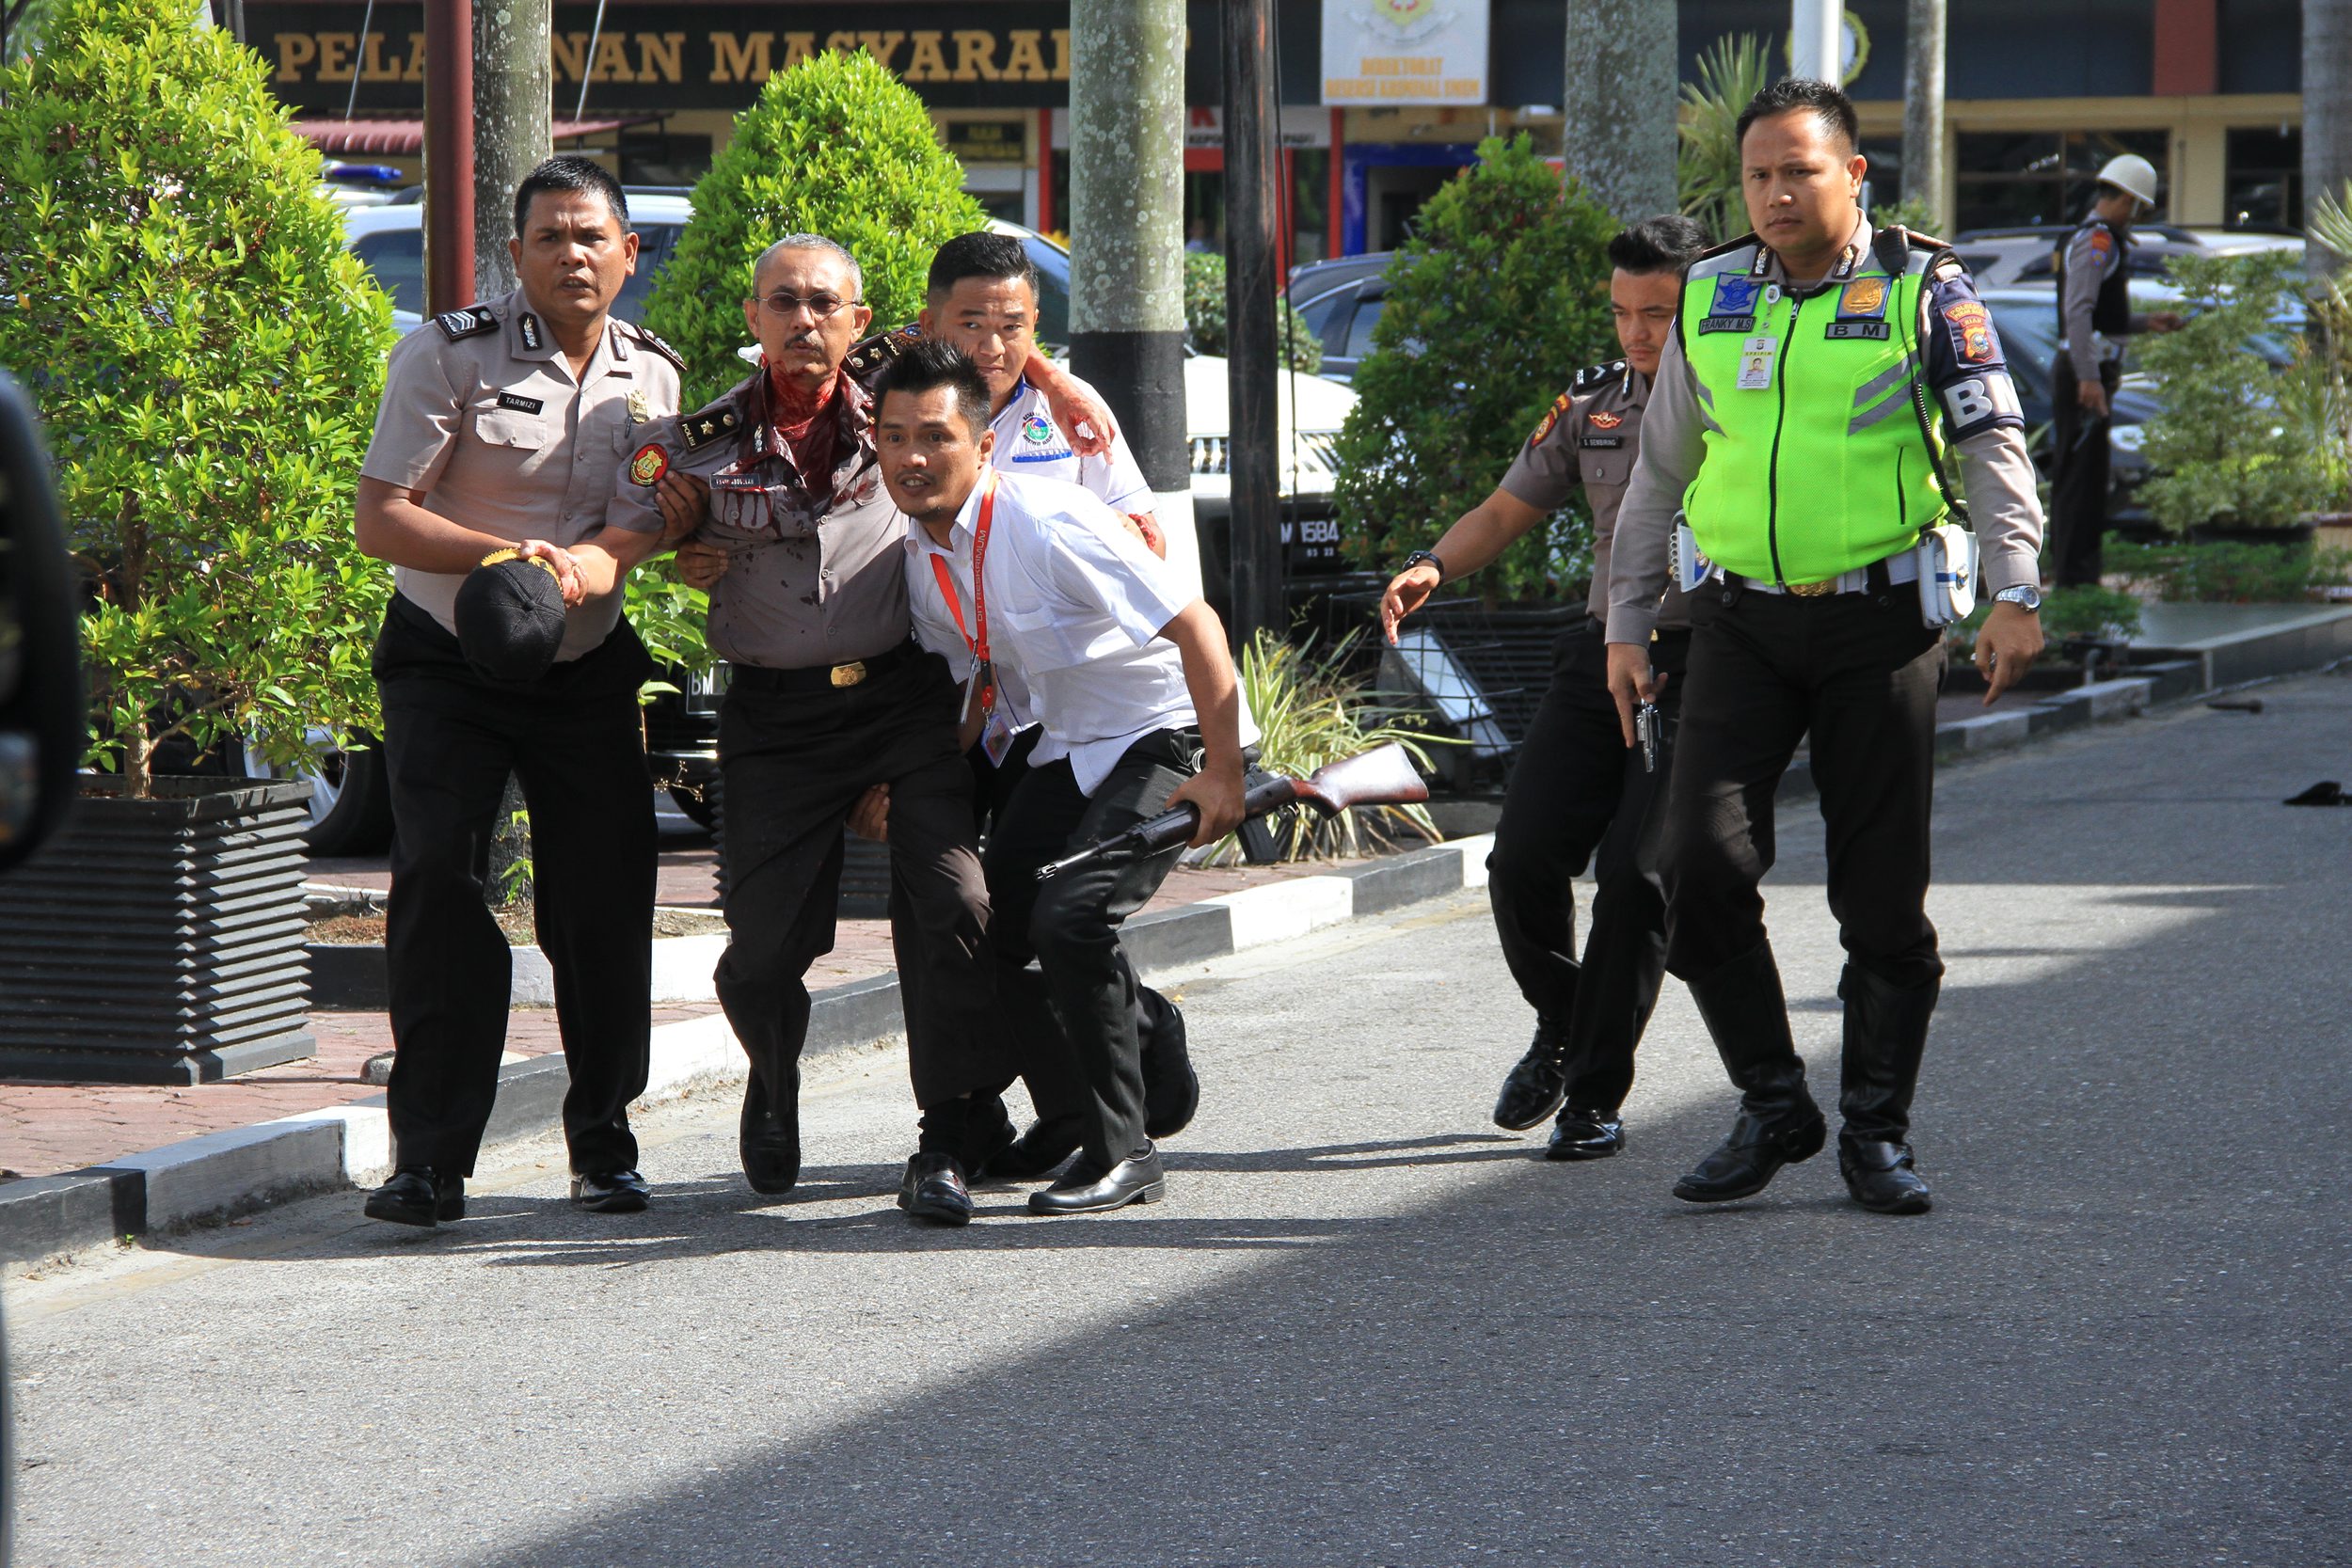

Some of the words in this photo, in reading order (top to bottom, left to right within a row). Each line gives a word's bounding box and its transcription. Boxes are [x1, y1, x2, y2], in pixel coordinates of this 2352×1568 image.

[274, 32, 686, 83] PELNAN
[1701, 319, 1734, 331] FRANKY
[1834, 325, 1849, 336] B
[1862, 324, 1881, 337] M
[505, 396, 536, 409] TARMIZI
[681, 423, 696, 447] POLISI
[975, 530, 987, 601] RESKRIMUM
